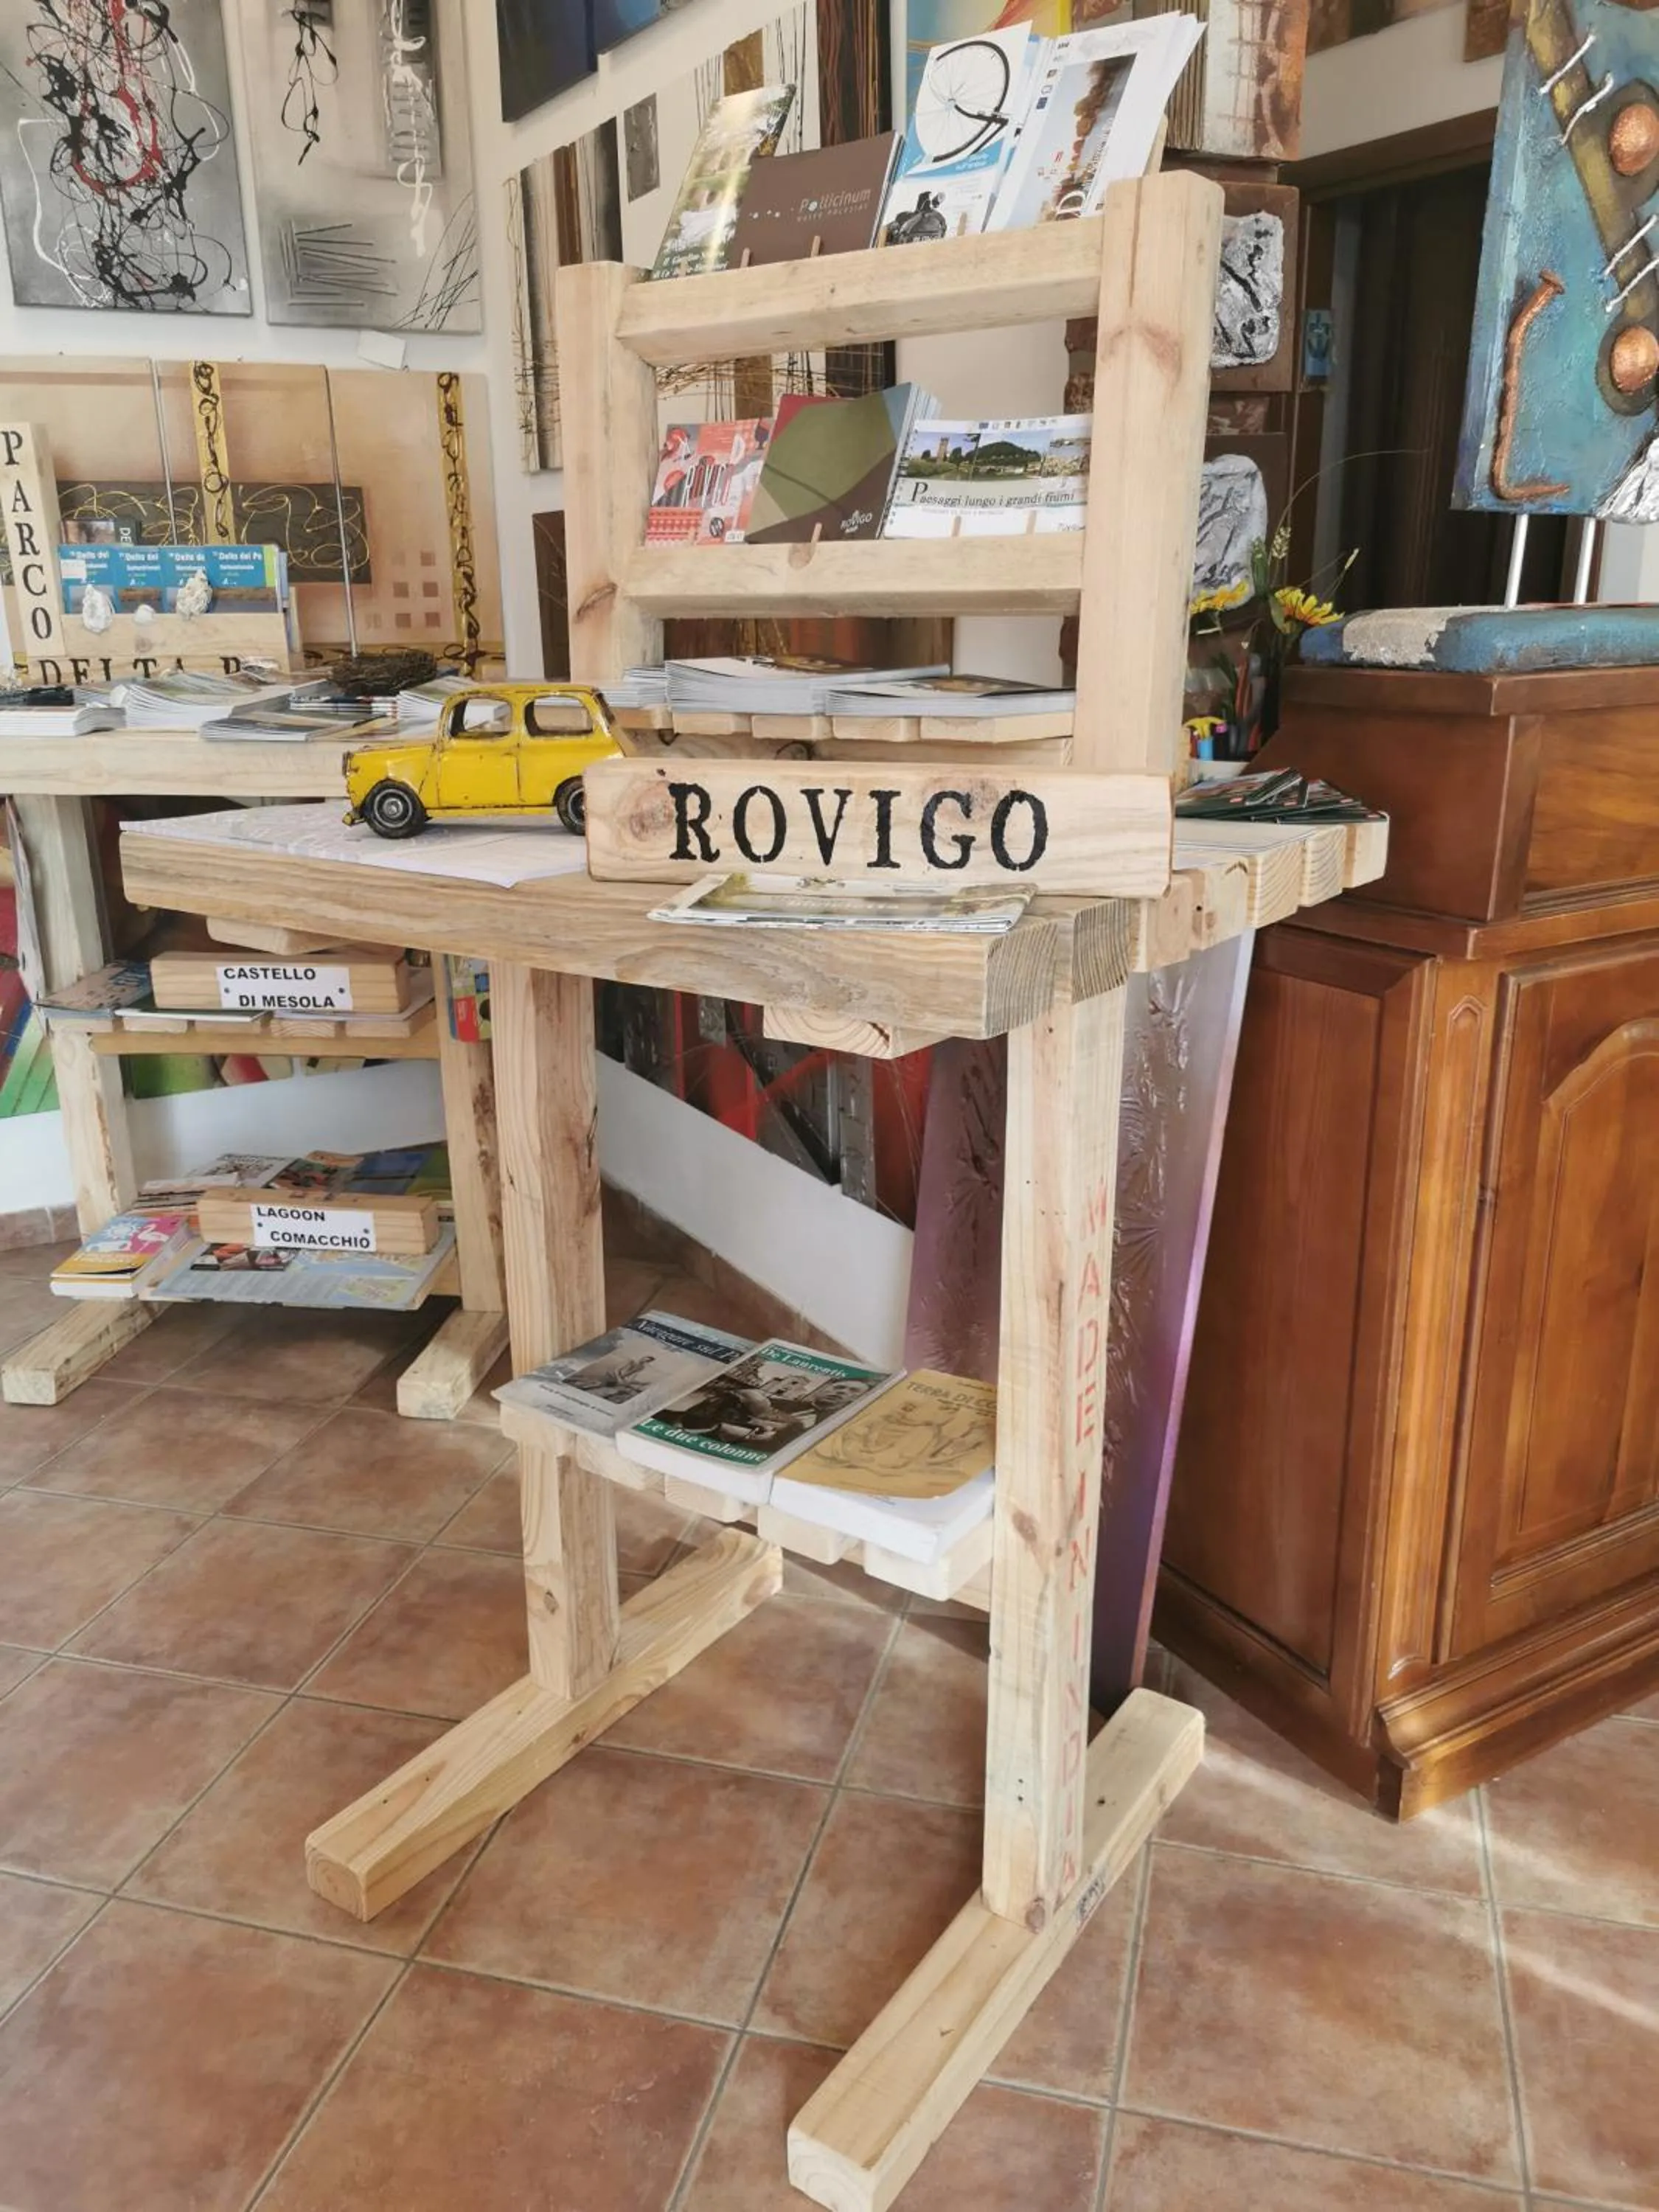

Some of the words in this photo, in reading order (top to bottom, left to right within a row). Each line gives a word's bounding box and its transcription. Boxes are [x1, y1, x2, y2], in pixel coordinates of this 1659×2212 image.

[911, 481, 961, 507] Paesaggi
[964, 494, 996, 507] lungo
[1006, 493, 1042, 507] grandi
[1044, 490, 1074, 504] fiumi
[1, 431, 52, 639] PARCO
[668, 782, 1049, 872] ROVIGO
[223, 967, 316, 980] CASTELLO
[239, 995, 256, 1007] DI
[262, 995, 335, 1008] MESOLA
[257, 1206, 325, 1221] LAGOON
[271, 1231, 370, 1249] COMACCHIO
[762, 1347, 779, 1358] De
[641, 1418, 663, 1432] Le
[664, 1428, 698, 1443] due
[700, 1439, 768, 1462] colonne
